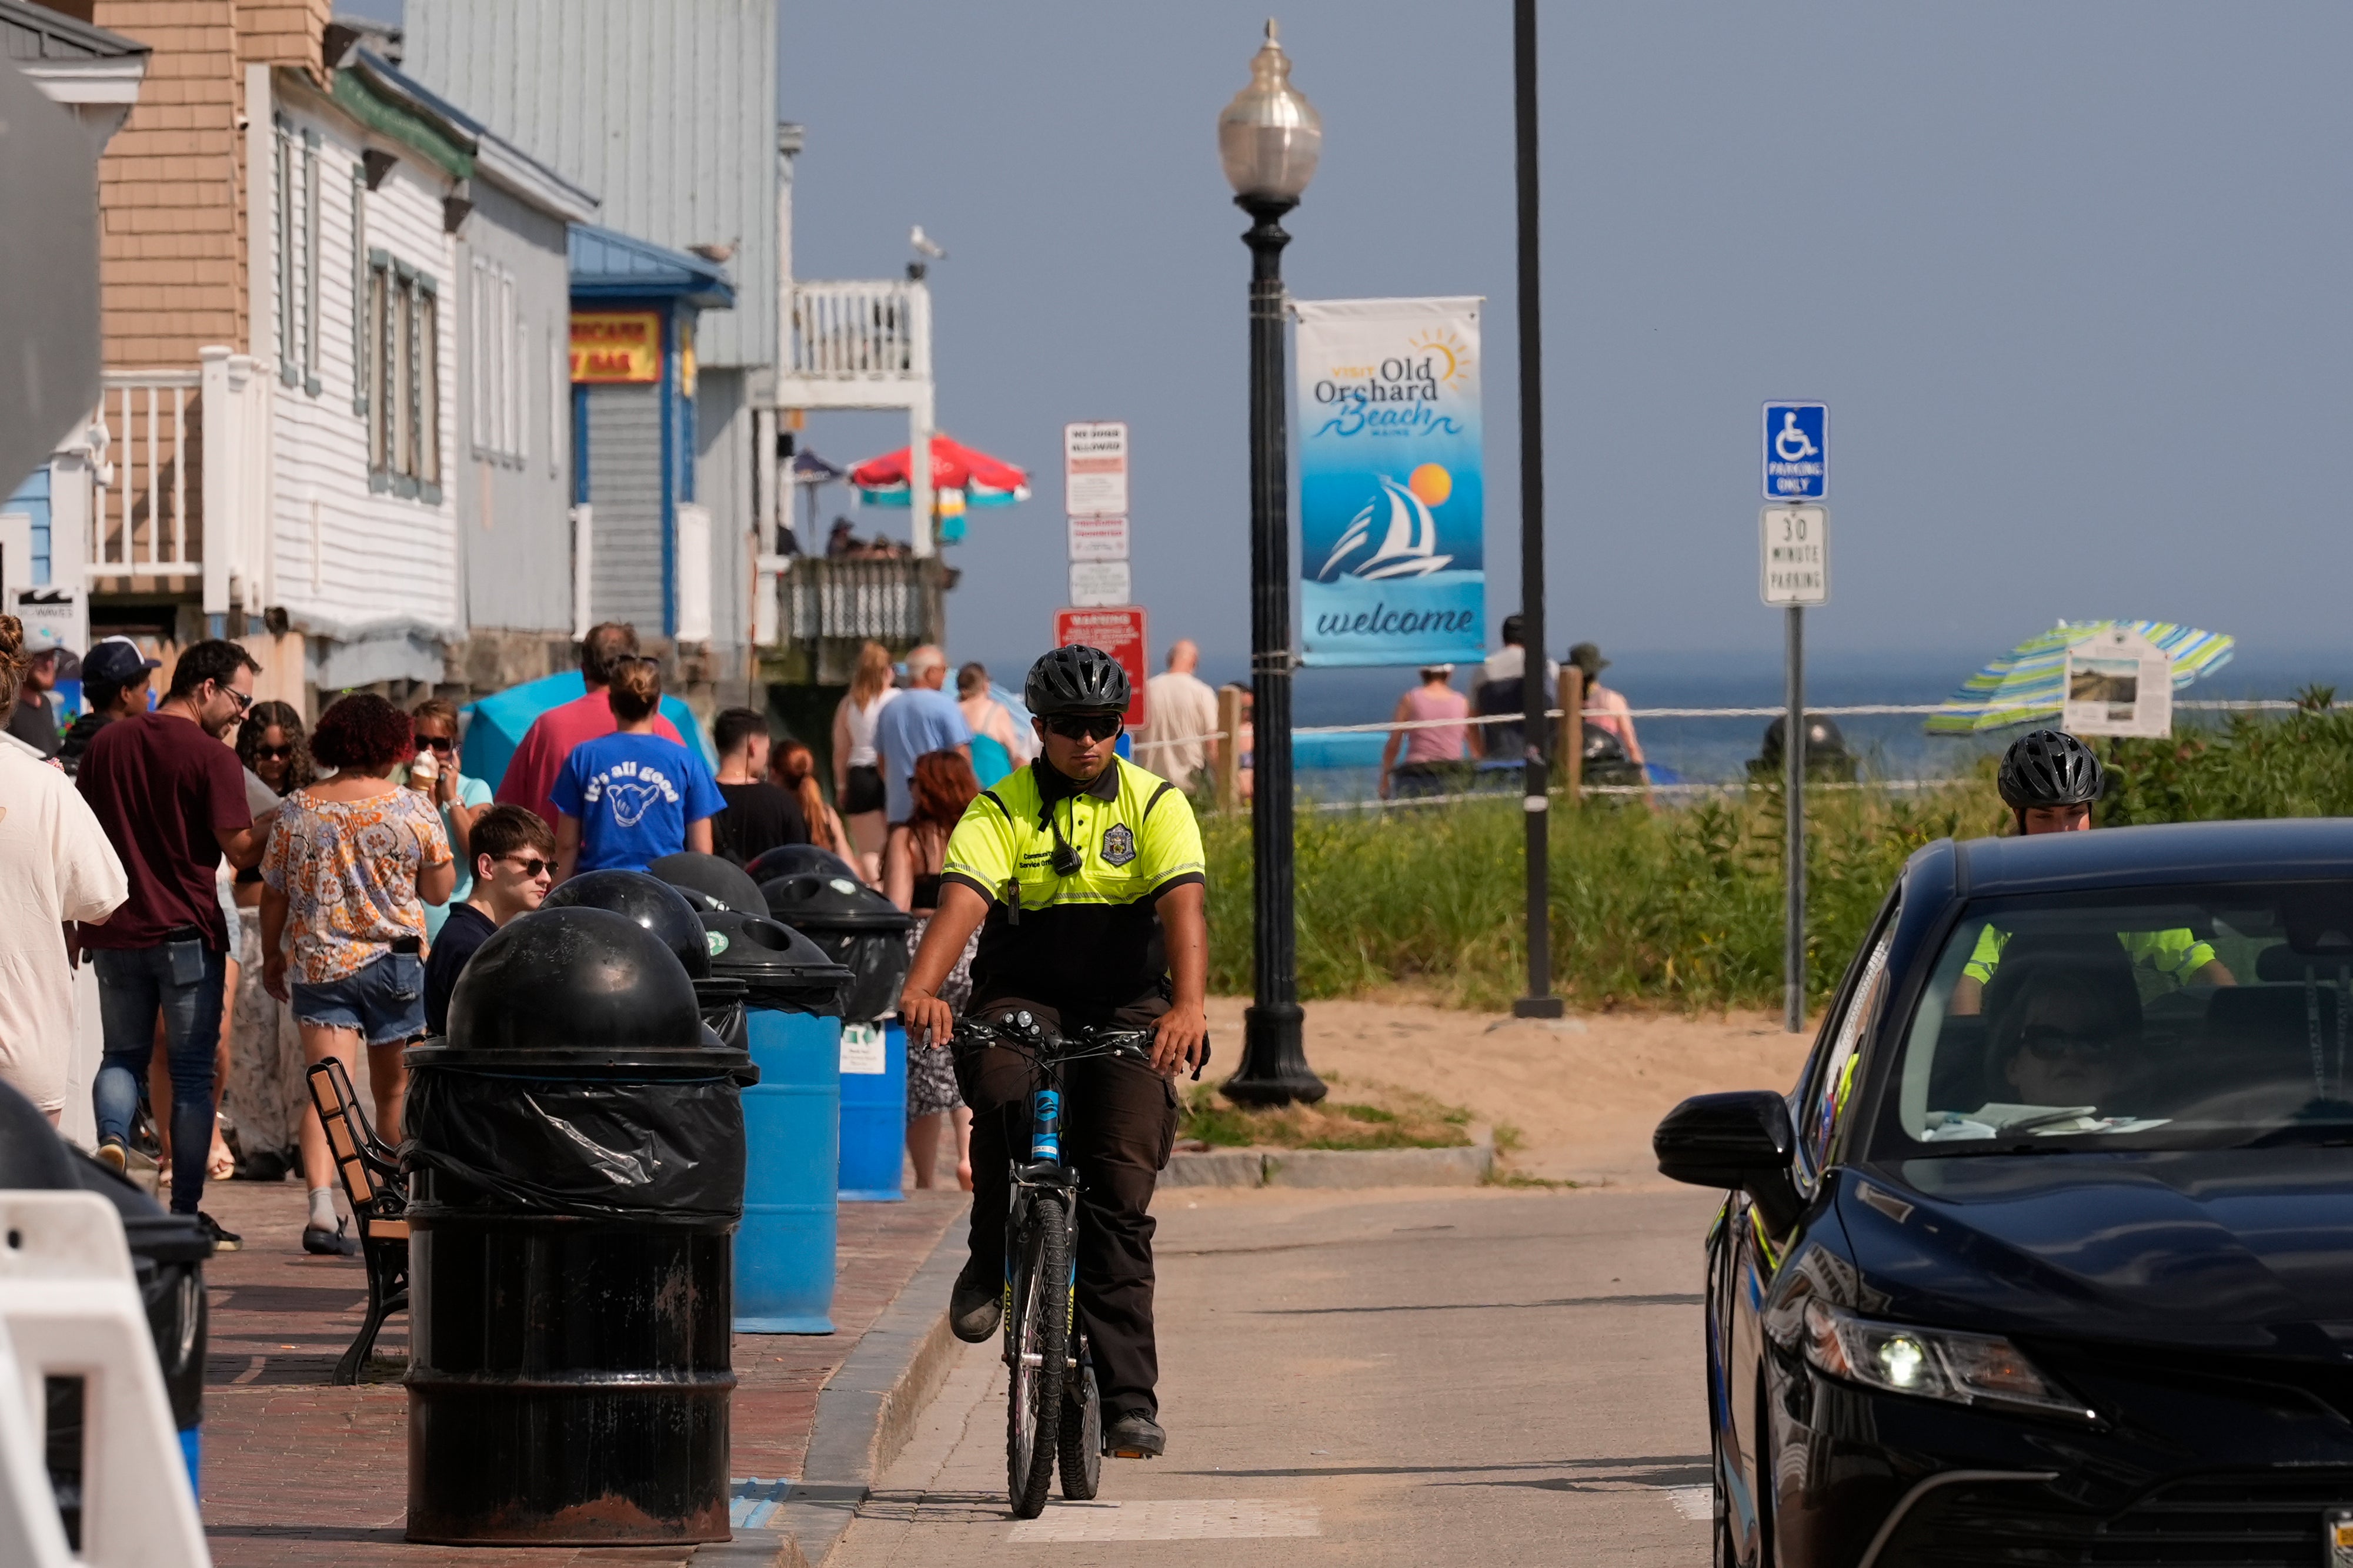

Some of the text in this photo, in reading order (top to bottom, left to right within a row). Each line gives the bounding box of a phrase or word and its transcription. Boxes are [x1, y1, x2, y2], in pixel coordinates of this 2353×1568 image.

[1332, 357, 1433, 383] VISIT Old
[1314, 378, 1437, 403] Orchard
[1329, 392, 1433, 436] Beach
[1769, 462, 1823, 476] PARKING
[1777, 477, 1810, 493] ONLY
[1783, 517, 1807, 542] 30
[1772, 545, 1820, 564] MINUTE
[1770, 571, 1820, 589] PARKING
[1317, 601, 1473, 636] welcome
[1023, 851, 1054, 860] Community
